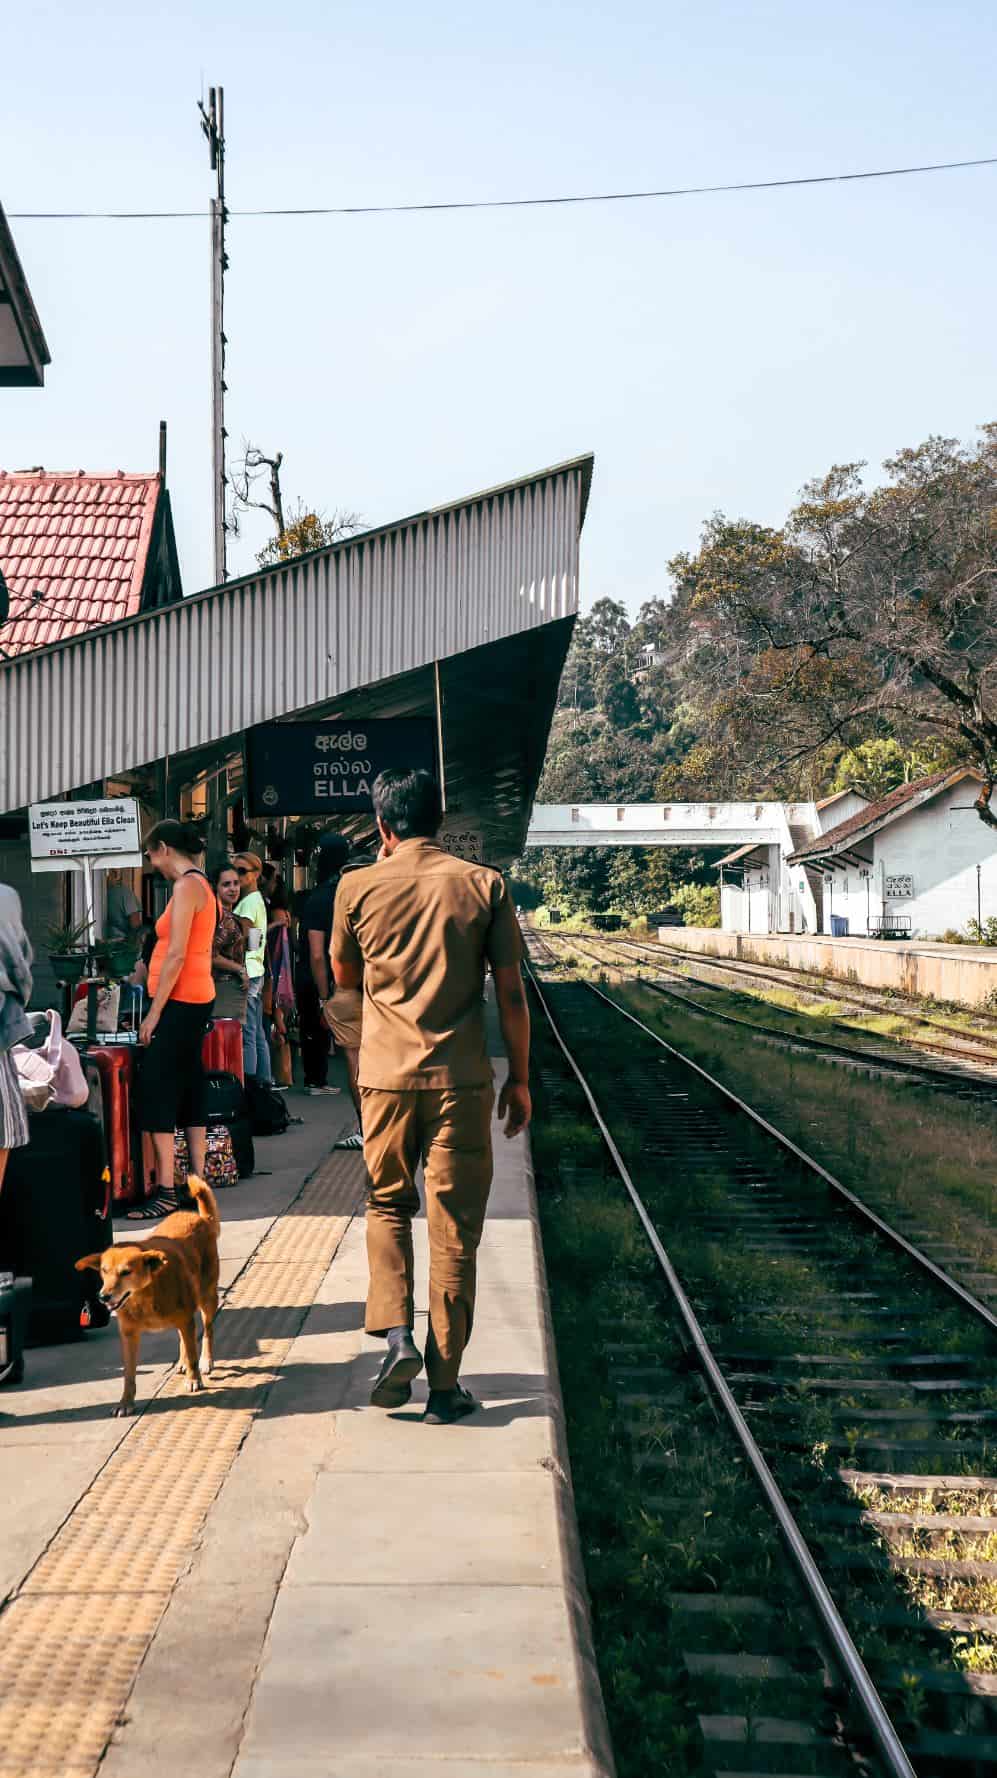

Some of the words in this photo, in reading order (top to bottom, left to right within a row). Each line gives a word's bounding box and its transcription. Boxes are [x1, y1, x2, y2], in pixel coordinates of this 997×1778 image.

[314, 731, 367, 752] ඇල්ල
[313, 757, 371, 776] எல்ல
[314, 779, 371, 797] ELLA
[32, 820, 49, 830] Let's
[50, 820, 68, 829] Keep
[69, 818, 100, 828] Beautiful
[101, 817, 115, 825] Ella
[116, 816, 135, 825] Clean
